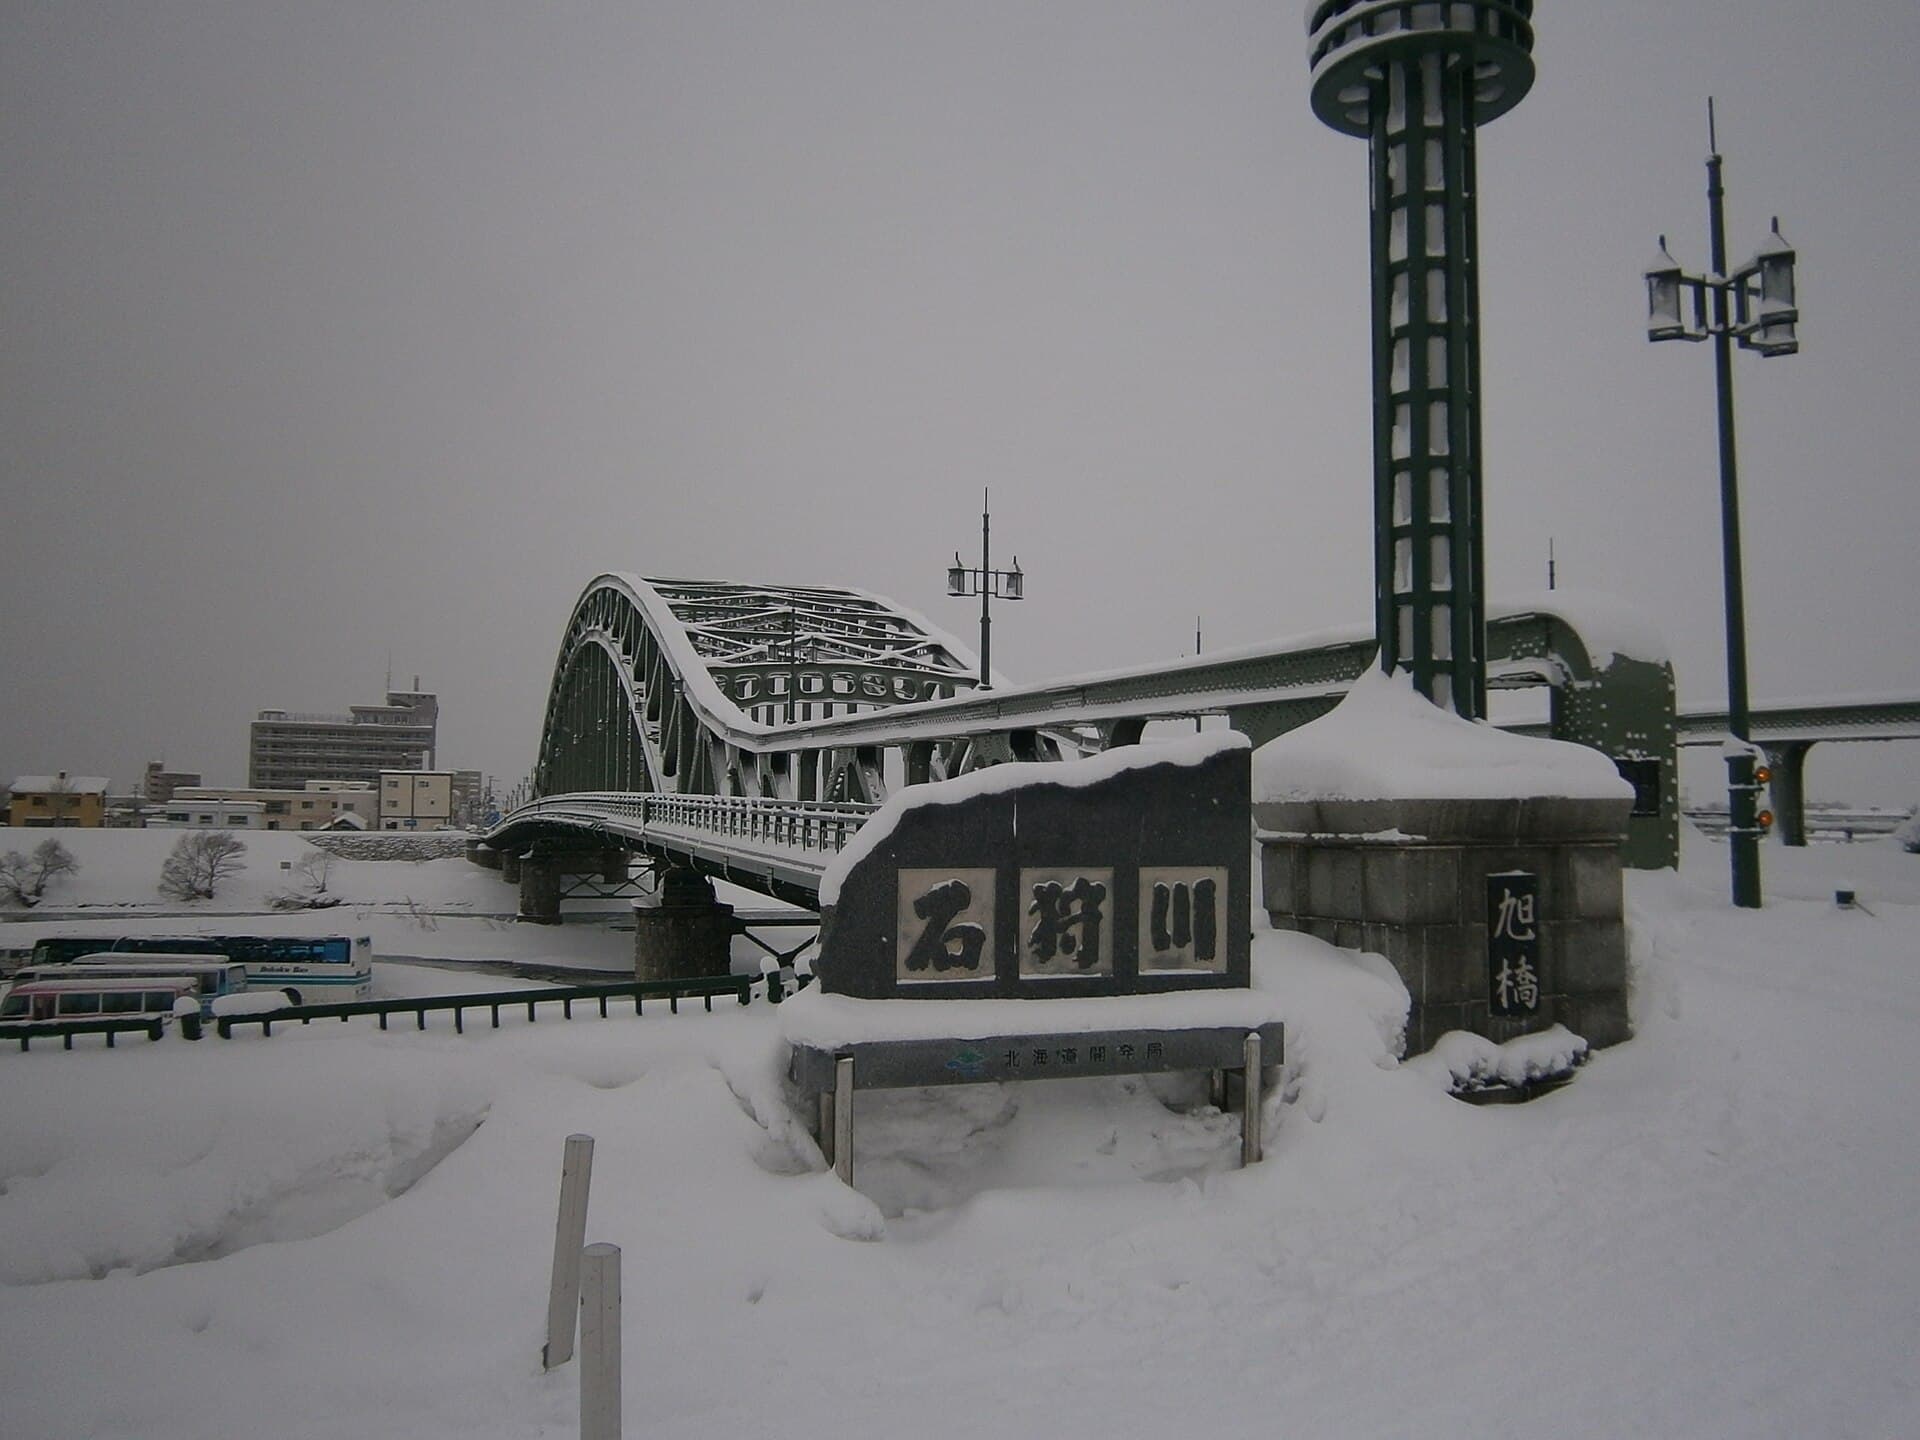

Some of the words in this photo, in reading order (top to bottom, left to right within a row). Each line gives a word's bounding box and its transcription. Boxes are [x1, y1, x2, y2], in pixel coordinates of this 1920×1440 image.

[905, 878, 1216, 970] 石狩川
[1494, 887, 1539, 1009] 旭橋
[1004, 1042, 1164, 1068] 北海道開発局
